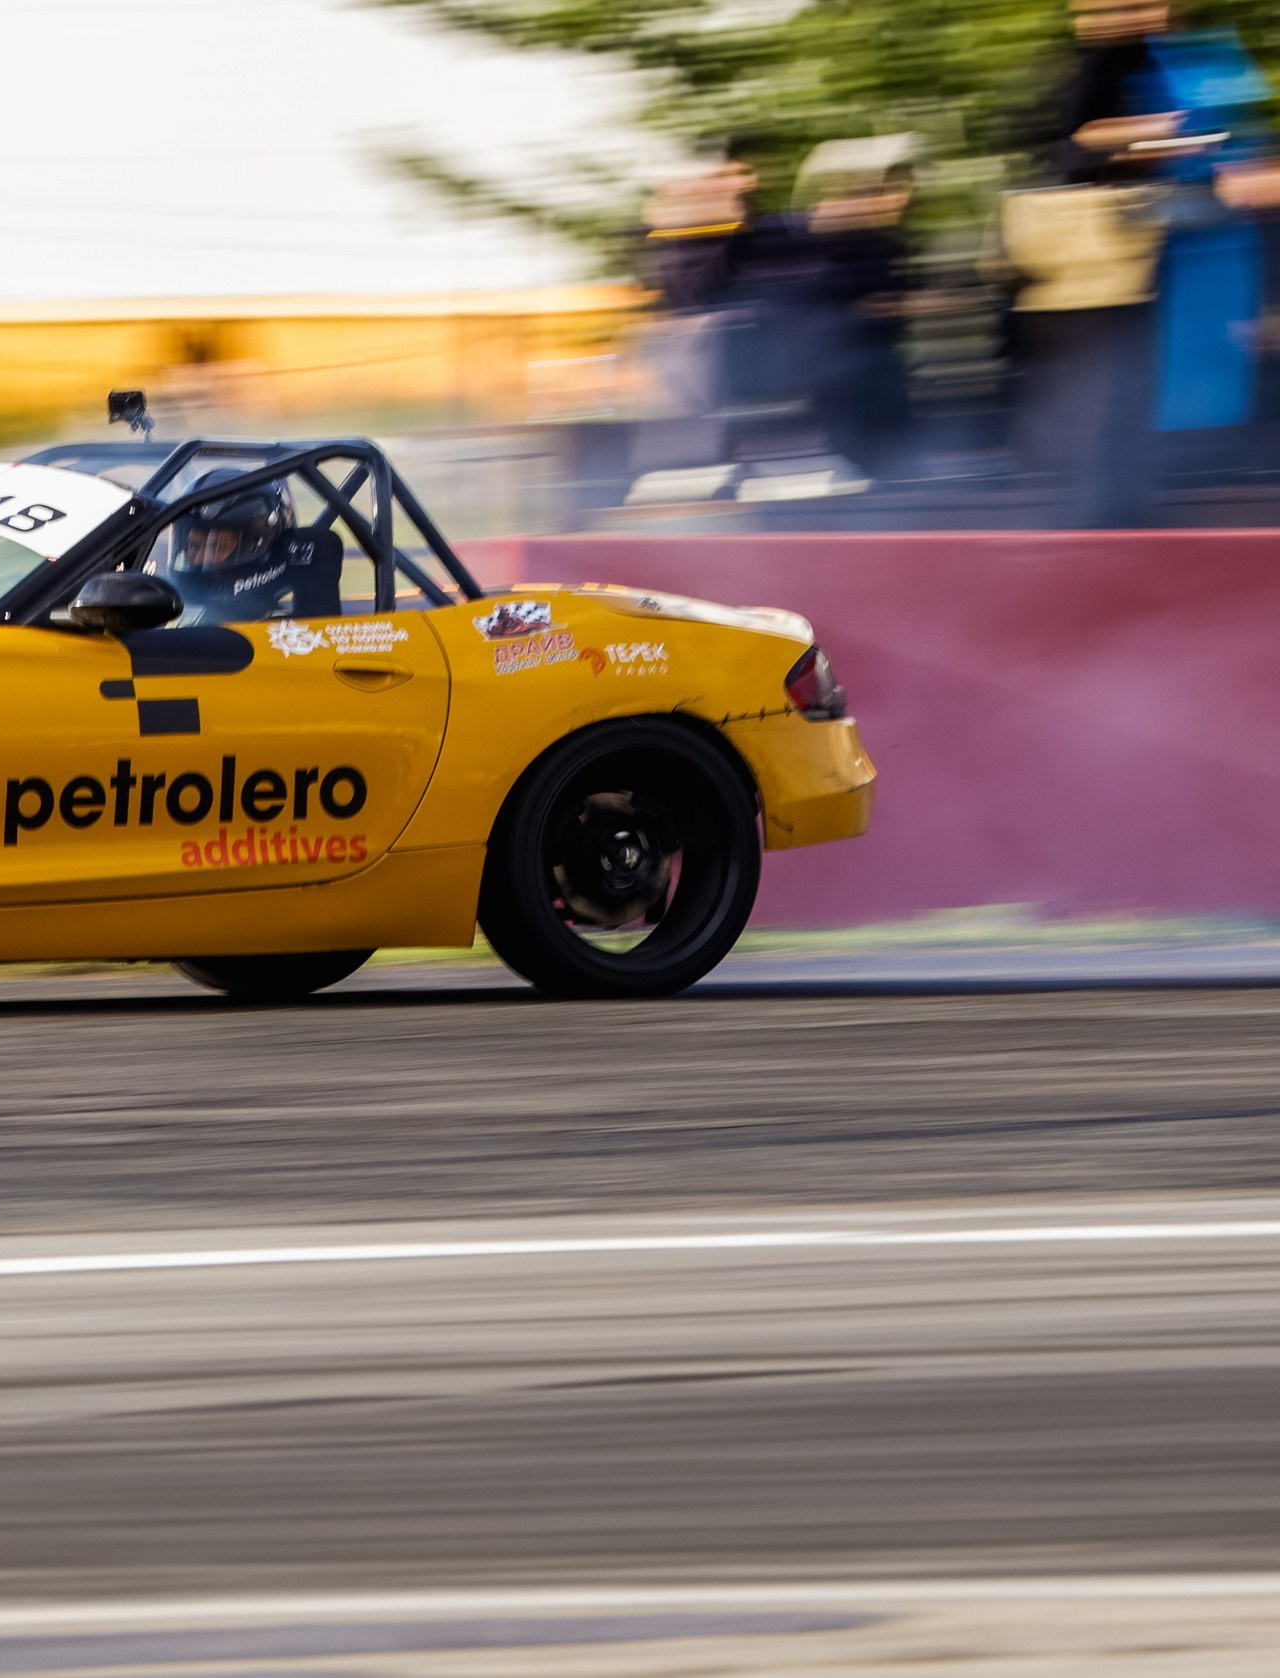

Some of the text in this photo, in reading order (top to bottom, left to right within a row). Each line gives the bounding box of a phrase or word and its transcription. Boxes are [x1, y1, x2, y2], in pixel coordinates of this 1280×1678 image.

[494, 631, 575, 664] ДРАЙВ
[604, 642, 669, 663] ТЕРЕК
[4, 754, 367, 847] petrolero
[181, 826, 368, 868] additives
